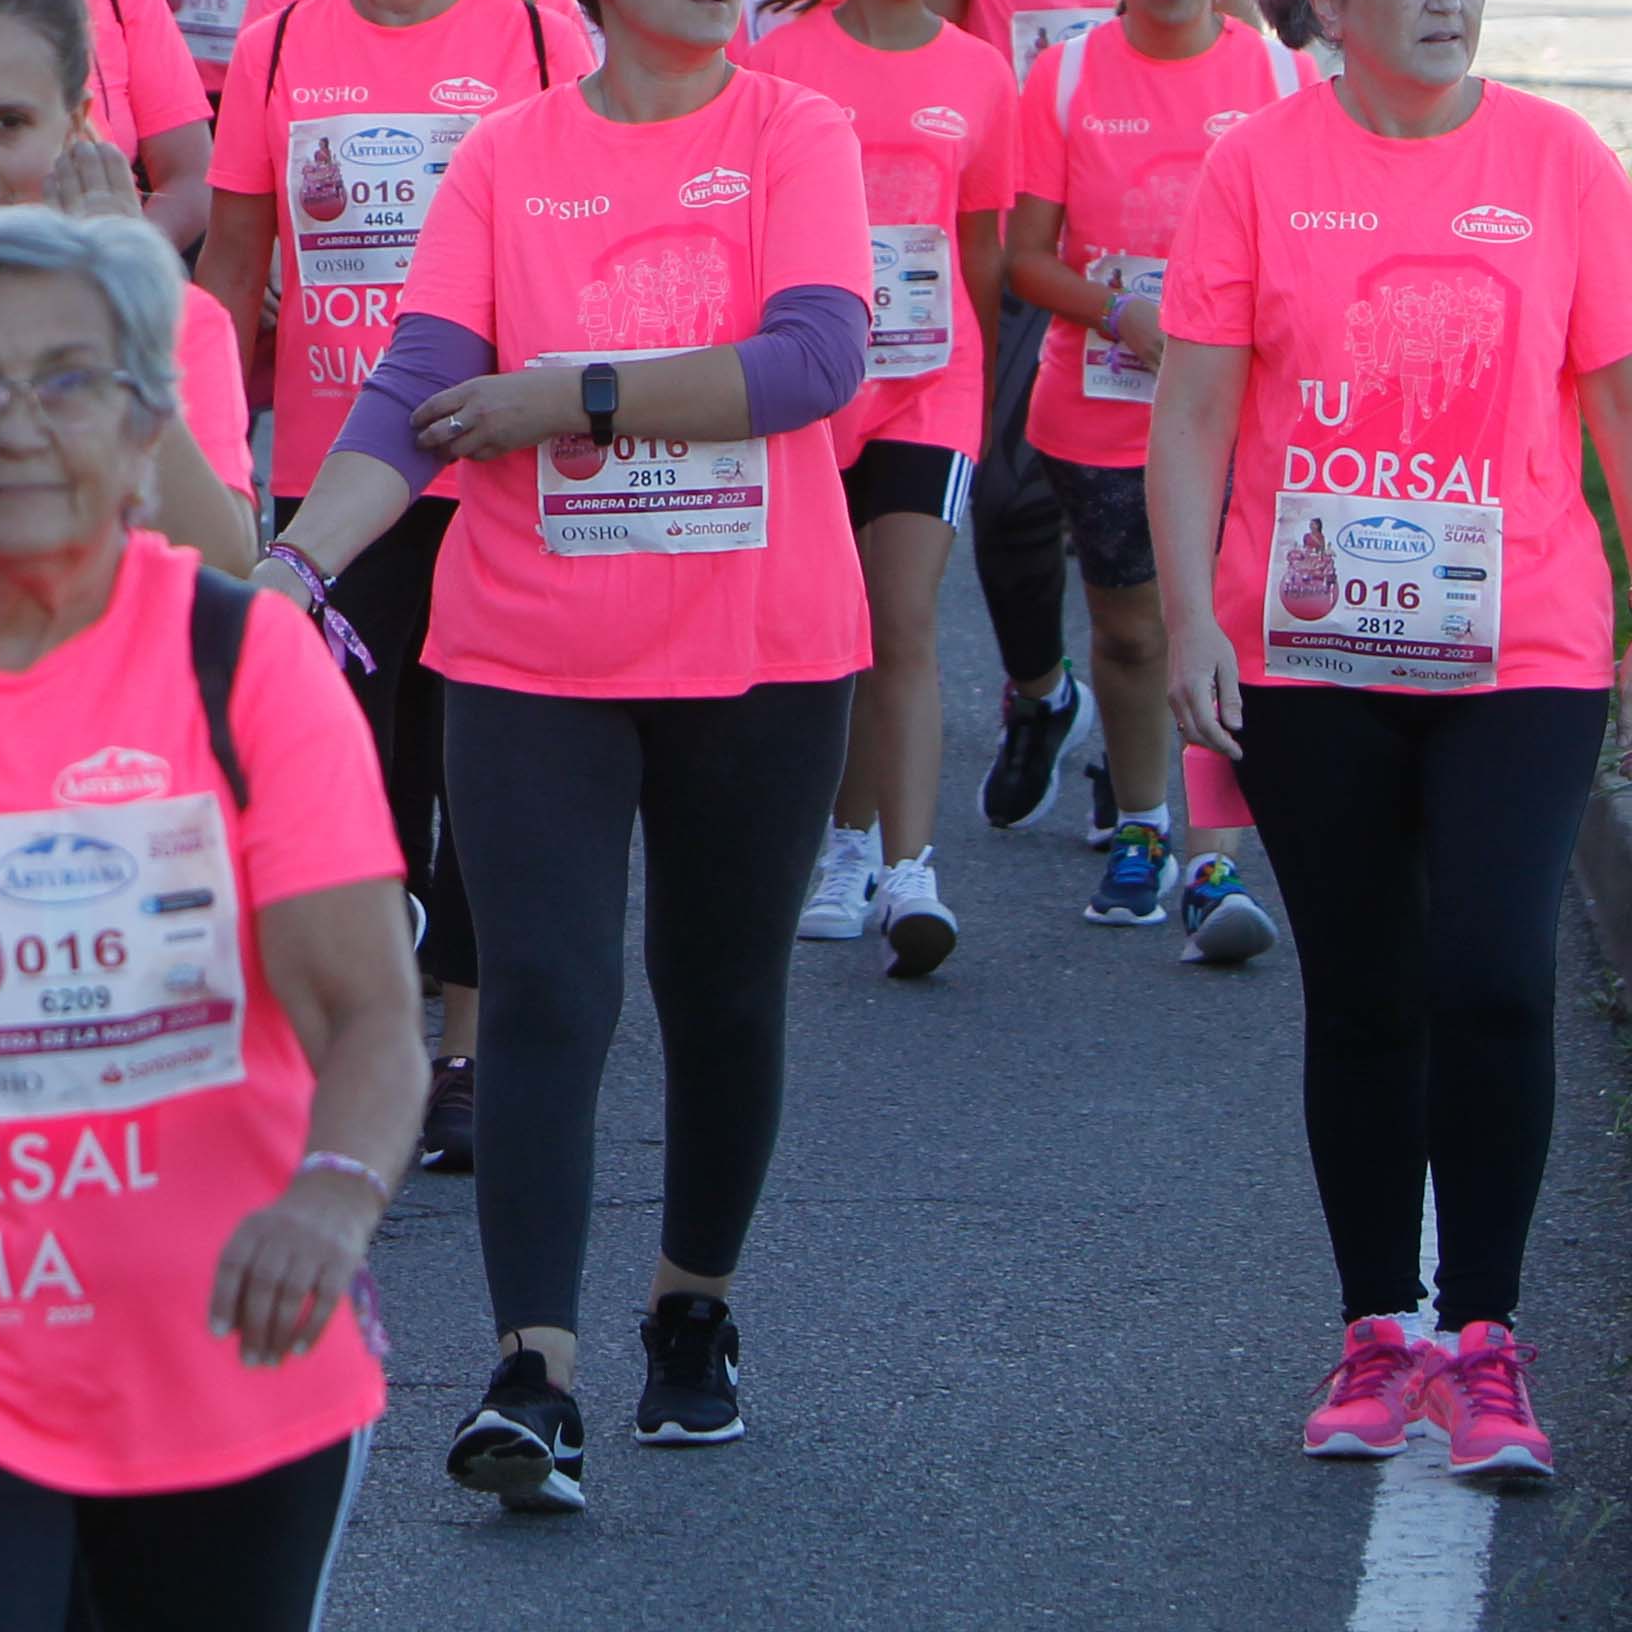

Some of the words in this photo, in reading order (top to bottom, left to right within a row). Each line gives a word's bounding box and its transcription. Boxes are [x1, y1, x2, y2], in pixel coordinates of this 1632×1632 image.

[292, 86, 368, 103] OYSHO
[437, 89, 492, 102] ASTURIANA
[1082, 115, 1150, 134] OYSHO
[347, 142, 418, 156] ASTURIANA
[352, 179, 416, 203] 016
[526, 195, 611, 220] OYSHO
[364, 212, 404, 226] 4464
[1290, 211, 1378, 231] OYSHO
[1459, 220, 1526, 236] ASTURIANA
[317, 236, 362, 247] CARRERA
[364, 235, 379, 245] DE
[381, 234, 395, 244] LA
[316, 259, 365, 273] OYSHO
[1298, 380, 1349, 427] TU
[613, 434, 689, 461] 016
[629, 469, 676, 487] 2813
[1283, 445, 1500, 504] DORSAL
[565, 497, 625, 511] CARRERA
[629, 497, 647, 508] DE
[650, 497, 666, 507] LA
[669, 495, 713, 506] MUJER
[717, 492, 747, 504] 2023
[562, 525, 629, 542] OYSHO
[686, 521, 752, 536] Santander
[1444, 531, 1486, 544] SUMA
[1344, 530, 1426, 553] ASTURIANA
[1344, 578, 1420, 609] 016
[1358, 617, 1404, 635] 2812
[1292, 635, 1351, 651] CARRERA
[1355, 642, 1373, 652] DE
[1376, 643, 1393, 654] LA
[1396, 644, 1440, 658] MUJER
[1445, 648, 1474, 658] 2023
[1287, 655, 1353, 674] OYSHO
[1409, 668, 1477, 681] Santander
[6, 867, 124, 890] ASTURIANA
[16, 930, 127, 975] 016
[41, 986, 111, 1013] 6209
[43, 1031, 66, 1045] DE
[72, 1027, 97, 1041] LA
[127, 1046, 212, 1078] Santander
